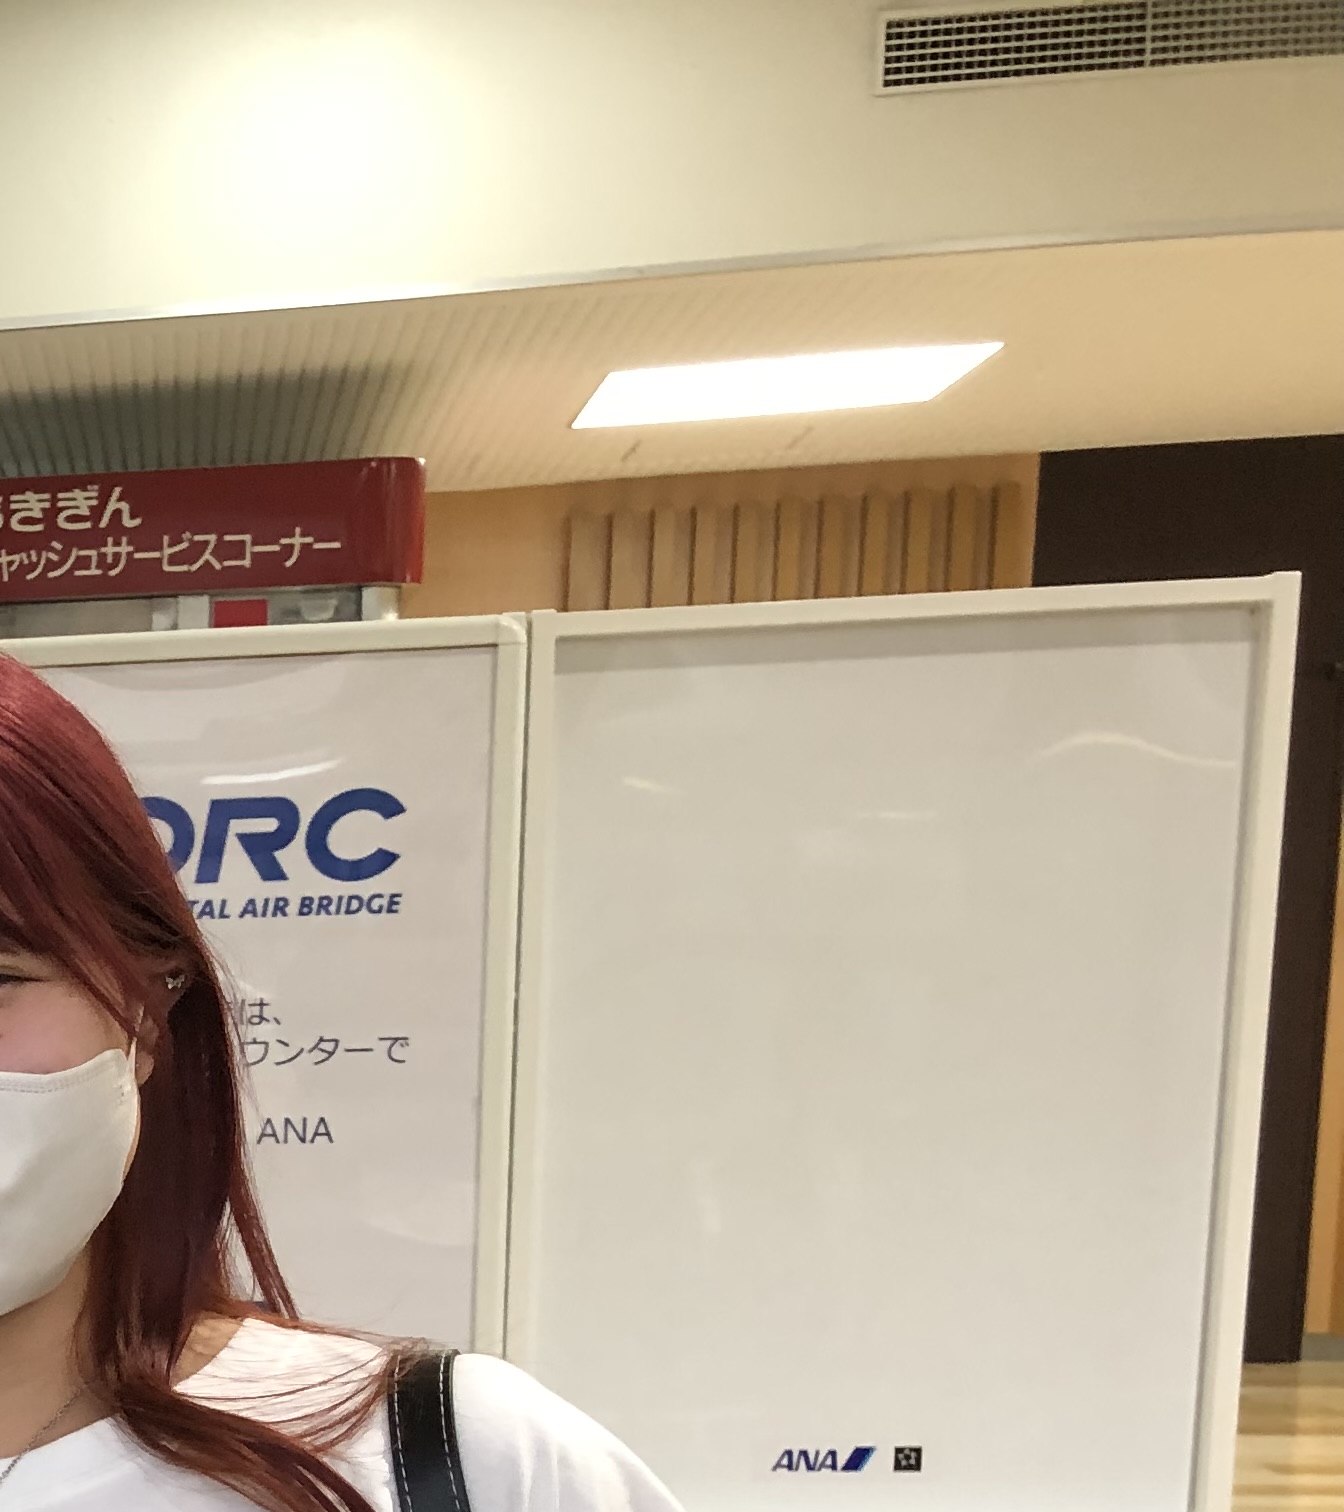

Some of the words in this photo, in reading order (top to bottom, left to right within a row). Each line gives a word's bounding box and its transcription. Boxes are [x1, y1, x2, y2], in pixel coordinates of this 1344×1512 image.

[238, 897, 290, 918] AIR
[297, 893, 403, 916] BRIDGE
[256, 1116, 335, 1145] ANA
[770, 1448, 838, 1472] ANA
